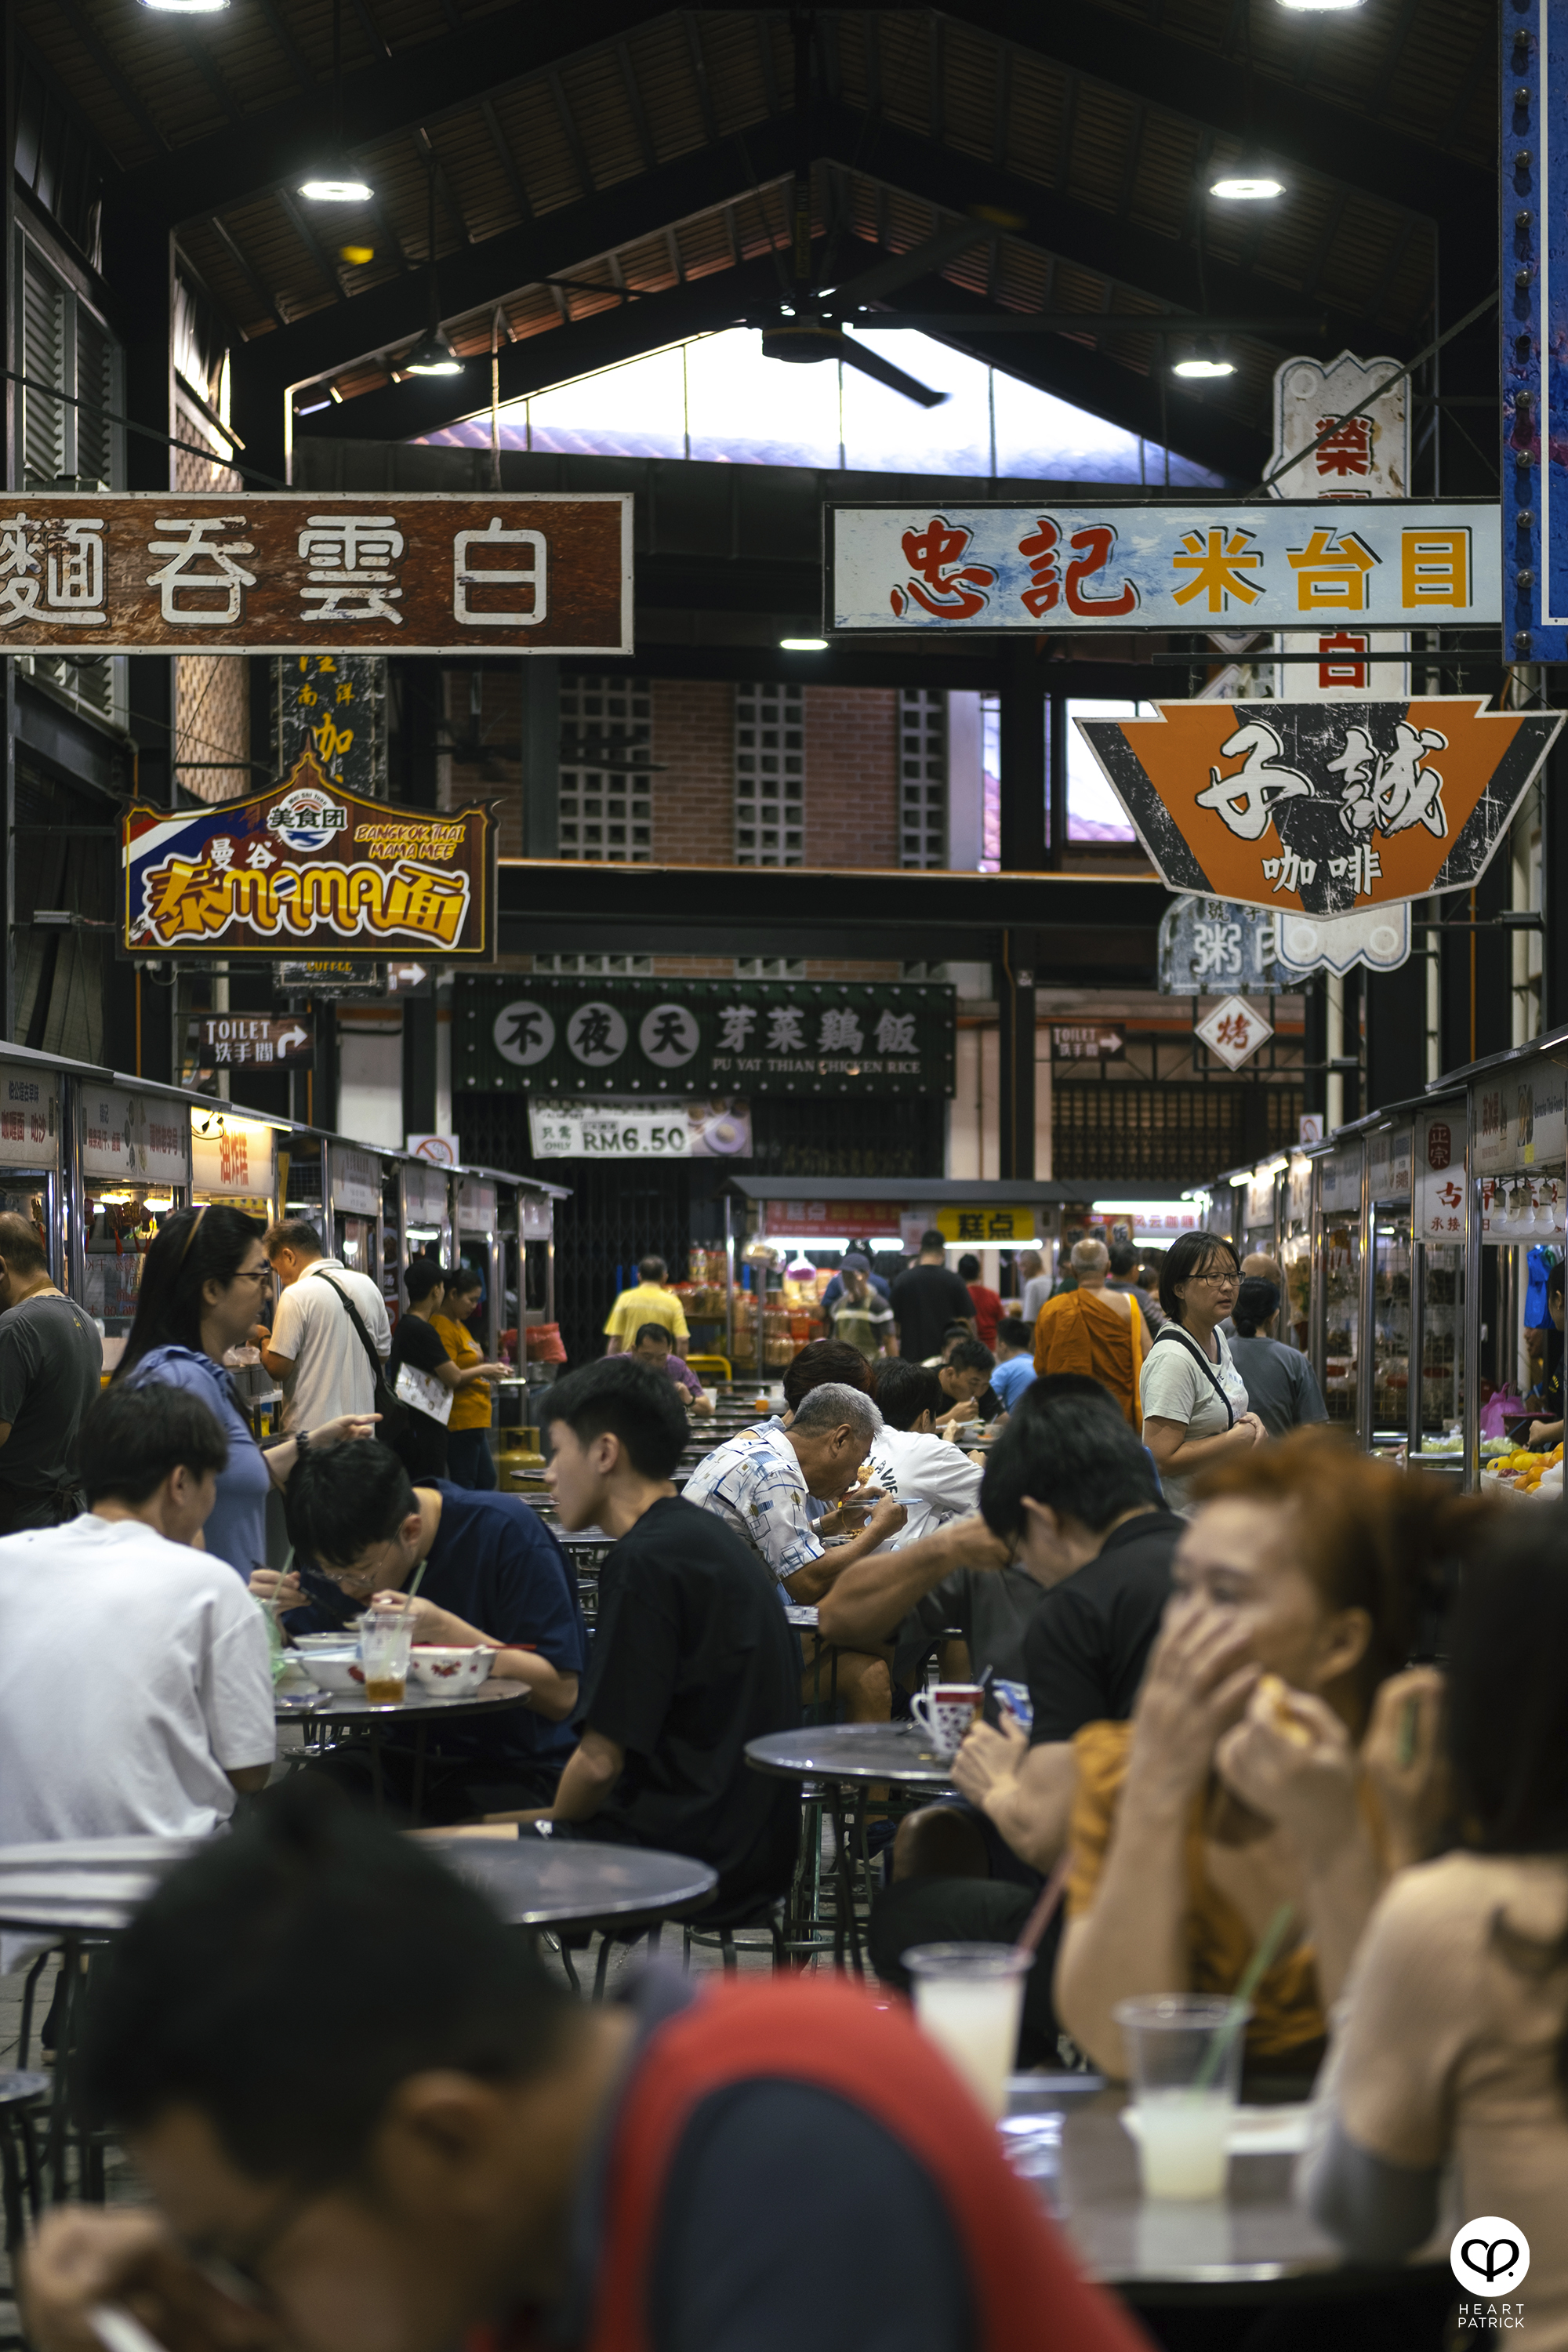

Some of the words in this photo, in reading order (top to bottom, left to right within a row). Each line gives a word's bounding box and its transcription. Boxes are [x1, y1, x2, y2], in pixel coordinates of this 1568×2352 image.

[268, 807, 346, 829] 美食团
[354, 823, 430, 844] BANGKOK
[431, 823, 467, 843] THAI
[210, 838, 278, 872] 曼谷
[367, 842, 416, 861] MAMA
[417, 842, 457, 861] MEE
[1261, 843, 1383, 896] 咖啡
[205, 1020, 271, 1045] TOILET
[502, 1007, 692, 1058] 不夜天
[1053, 1027, 1097, 1045] TOILET
[1216, 1013, 1250, 1051] 烤
[713, 1059, 732, 1072] PU
[818, 1061, 884, 1076] CHICKEN
[886, 1061, 921, 1074] RICE
[544, 1141, 572, 1151] ONLY
[583, 1127, 685, 1152] RM6.50
[1430, 1126, 1449, 1166] 正宗
[958, 1213, 1014, 1240] 糕点
